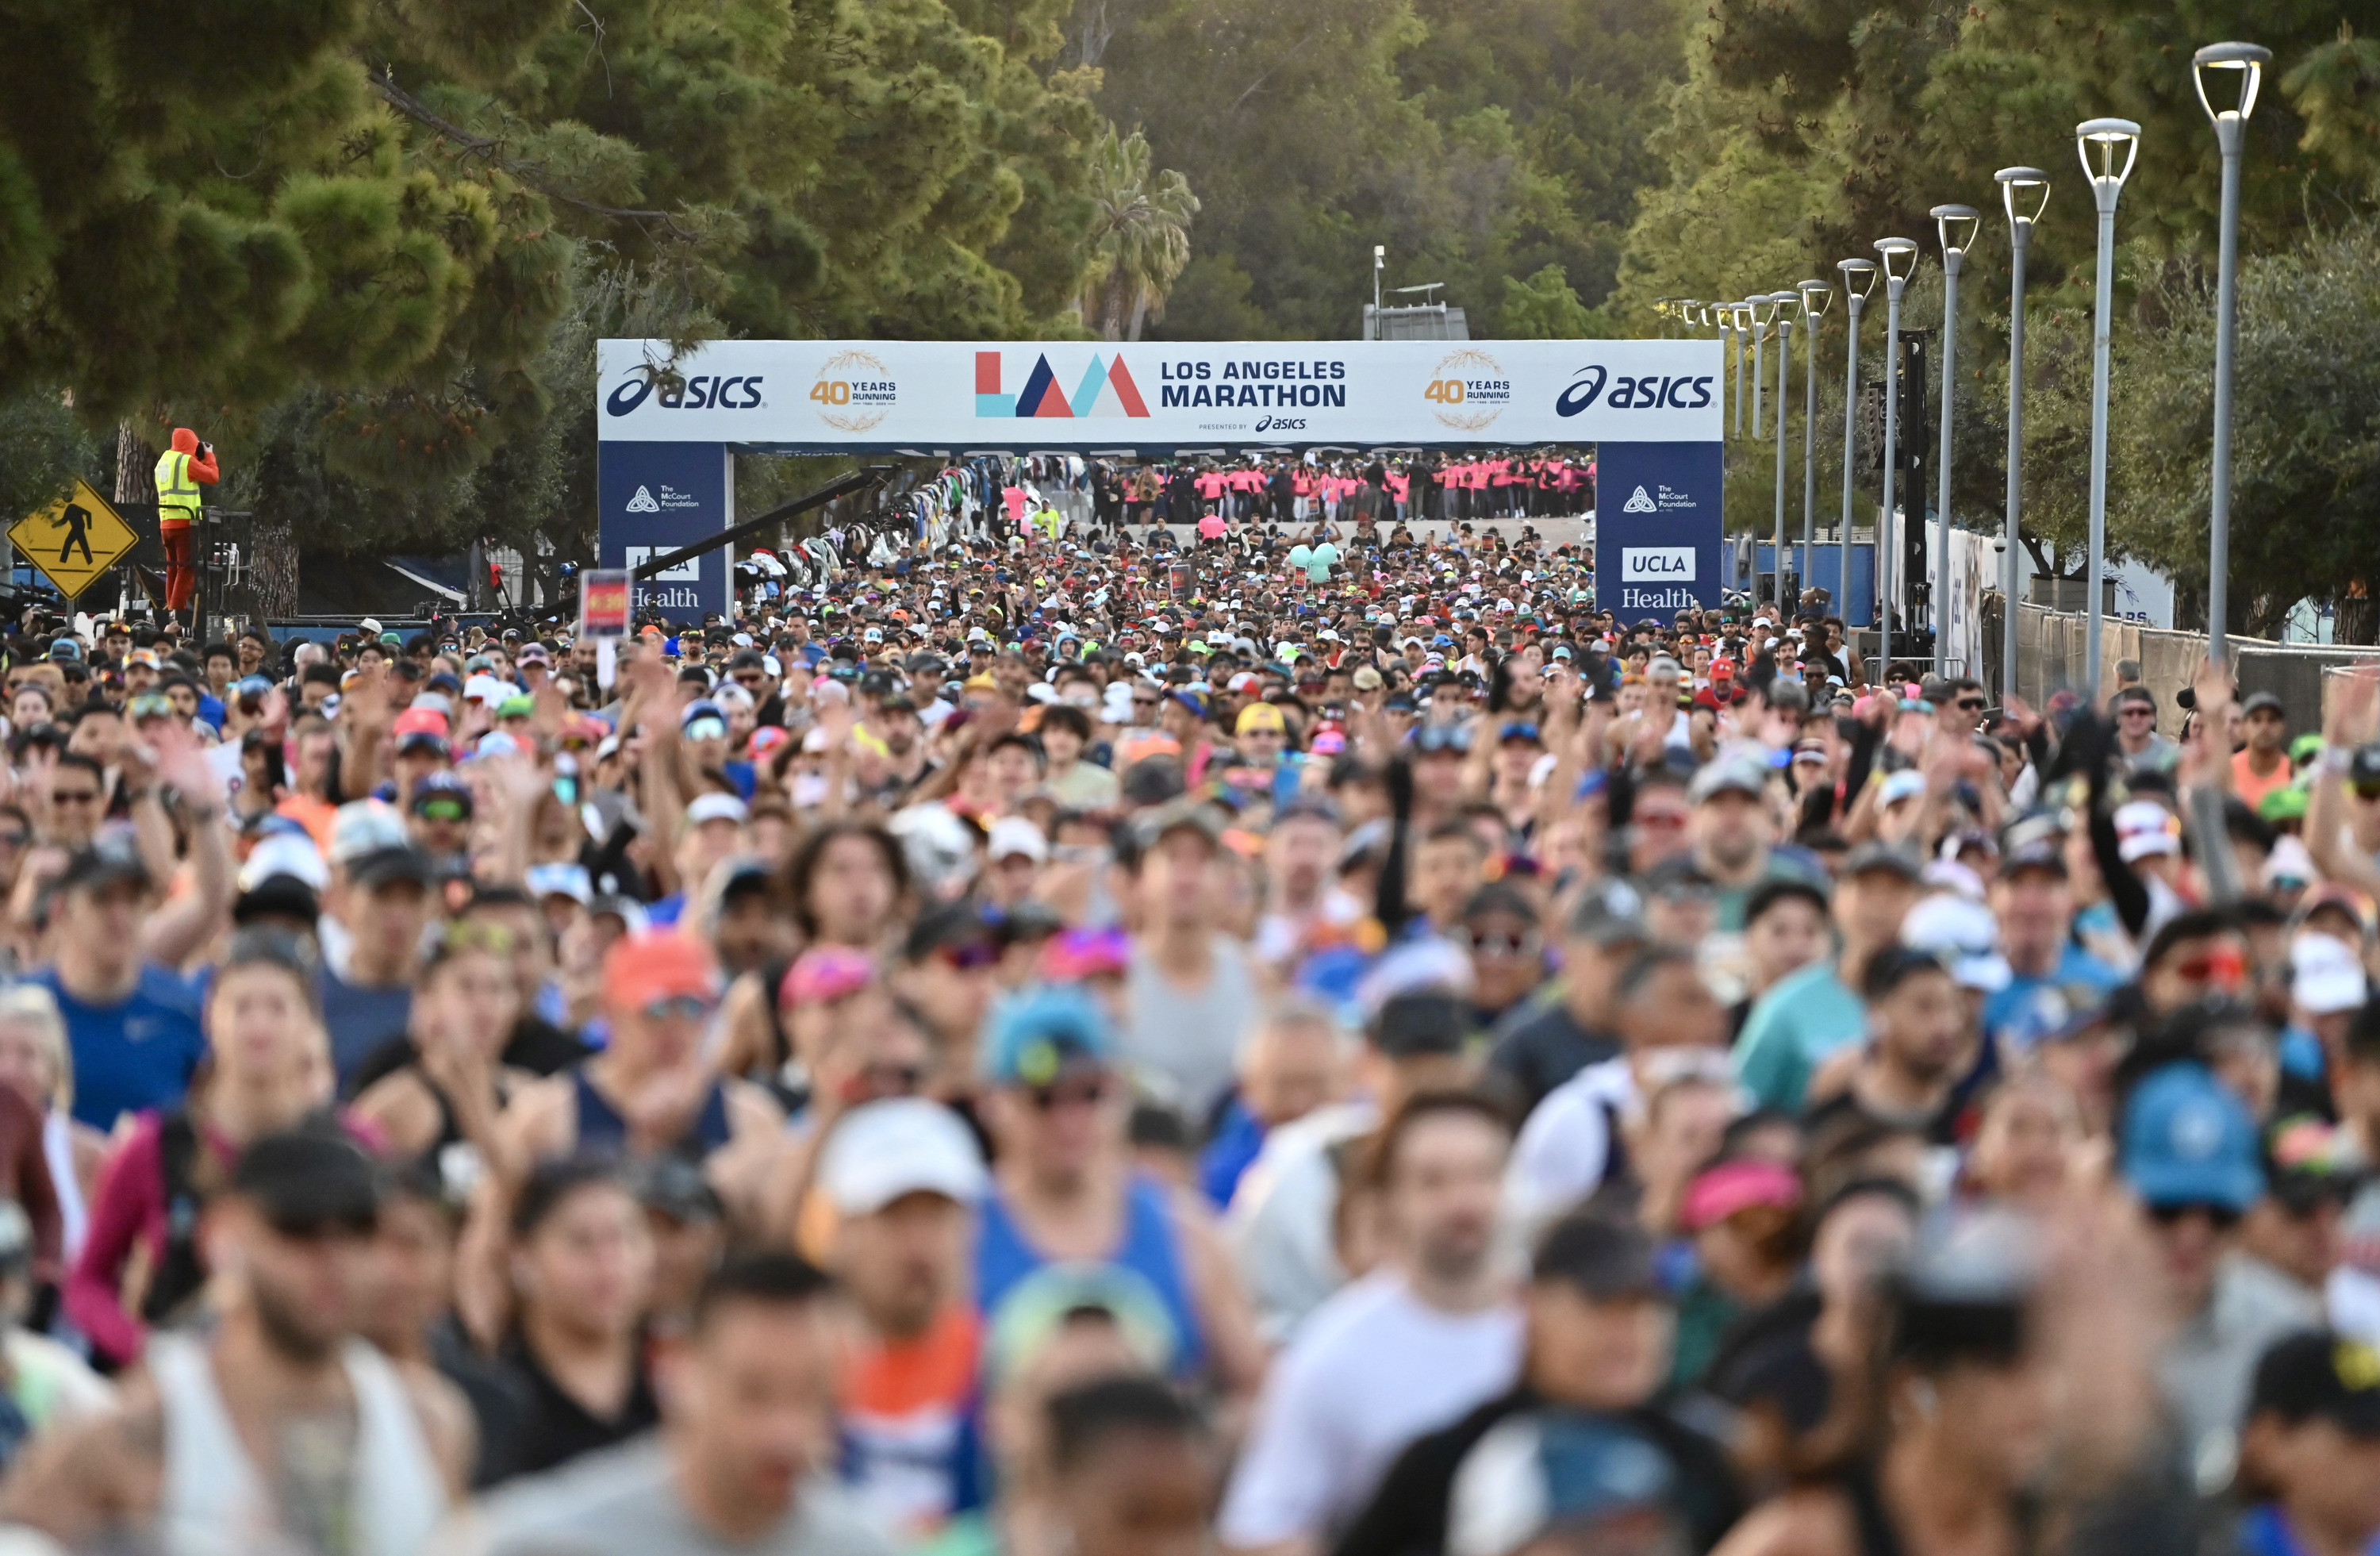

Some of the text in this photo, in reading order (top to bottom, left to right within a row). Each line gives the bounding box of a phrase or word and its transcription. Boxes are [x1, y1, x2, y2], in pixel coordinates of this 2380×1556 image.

[1161, 361, 1345, 380] LOS ANGELES
[810, 381, 850, 405] 40
[852, 382, 896, 391] YEARS
[1424, 379, 1464, 404] 40
[1467, 381, 1510, 390] YEARS
[1161, 385, 1345, 407] MARATHON
[1633, 555, 1686, 573] UCLA
[1622, 588, 1695, 609] Health
